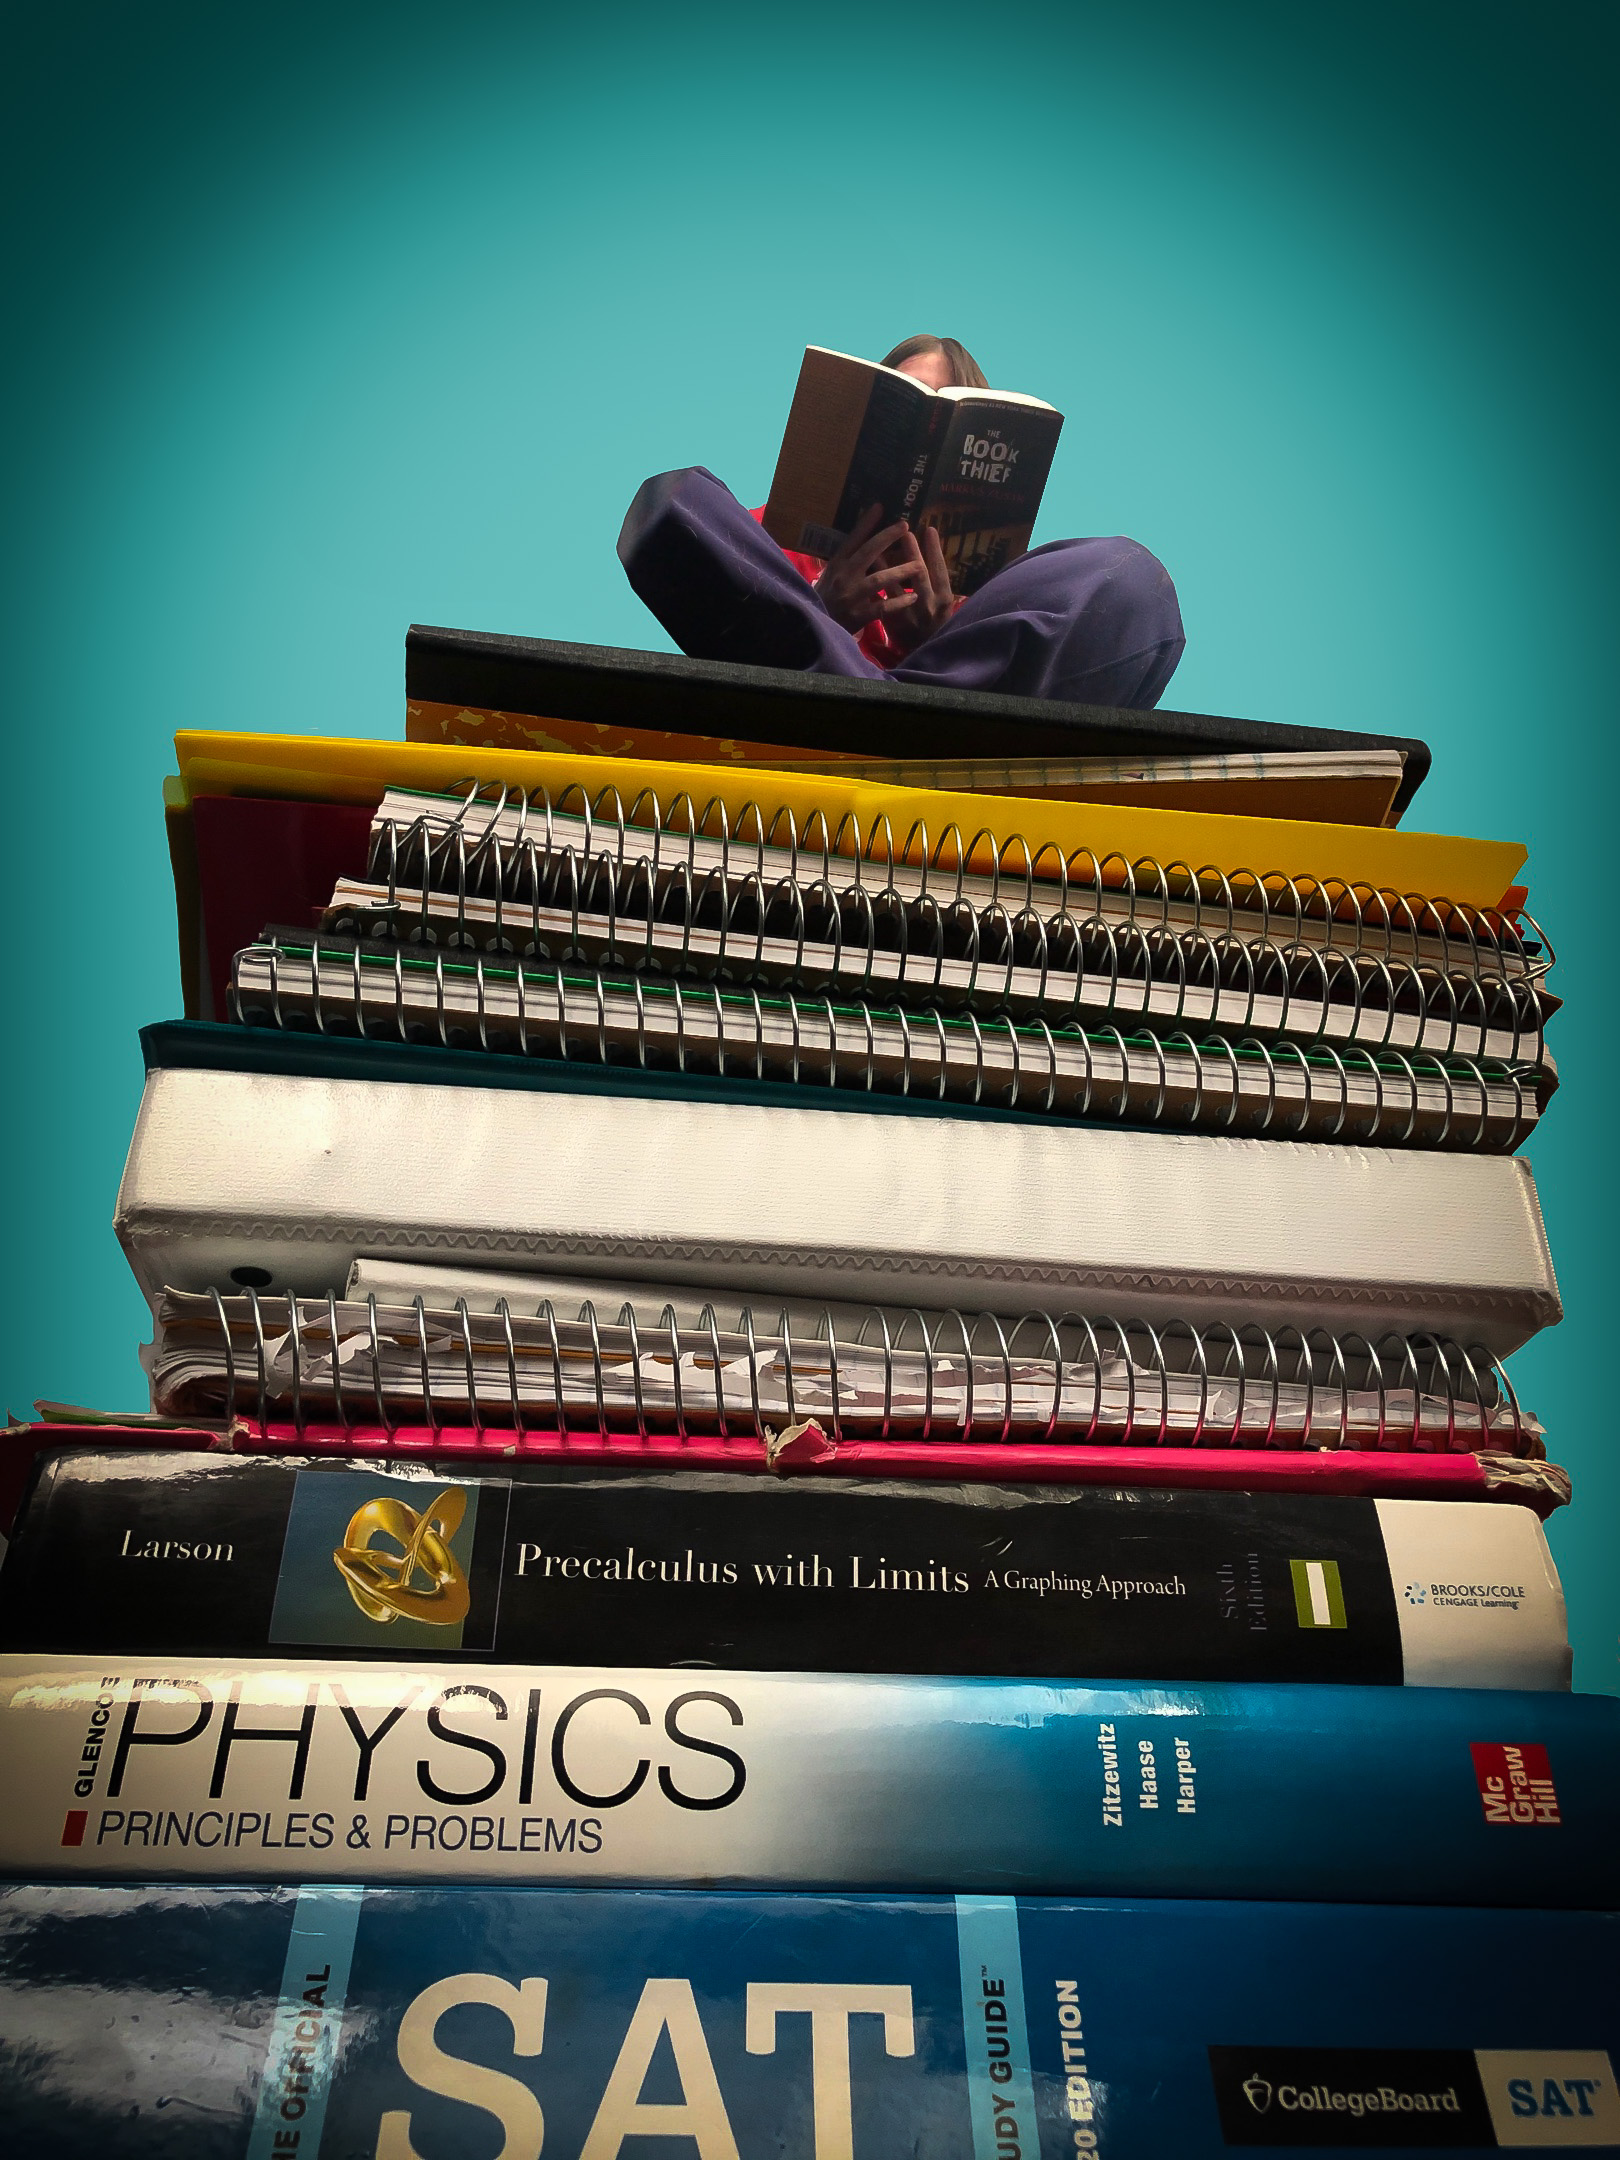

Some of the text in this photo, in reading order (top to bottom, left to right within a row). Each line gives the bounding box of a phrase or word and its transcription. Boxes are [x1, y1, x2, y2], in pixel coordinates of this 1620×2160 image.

[963, 434, 1020, 464] BOOK
[987, 429, 1001, 439] THE
[960, 459, 1012, 483] THIEF
[119, 1530, 235, 1563] Larson
[513, 1542, 970, 1594] Precalculus with Limits
[984, 1569, 1187, 1600] A Graphing Approach
[1430, 1583, 1526, 1599] BROOKS/COLE
[1433, 1597, 1520, 1611] CENGAGE Learning
[106, 1677, 748, 1812] PHYSICS
[1097, 1723, 1123, 1827] Zitzewitz
[1138, 1740, 1159, 1809] Haase
[1174, 1736, 1197, 1814] Harper
[1502, 1746, 1535, 1823] Graw
[1482, 1776, 1511, 1822] Mc
[1529, 1779, 1561, 1823] Hill
[96, 1809, 604, 1854] PRINCIPLES & PROBLEMS
[375, 1972, 916, 2160] SAT
[1055, 1979, 1094, 2122] EDITION
[1277, 2085, 1463, 2118] CollegeBoard
